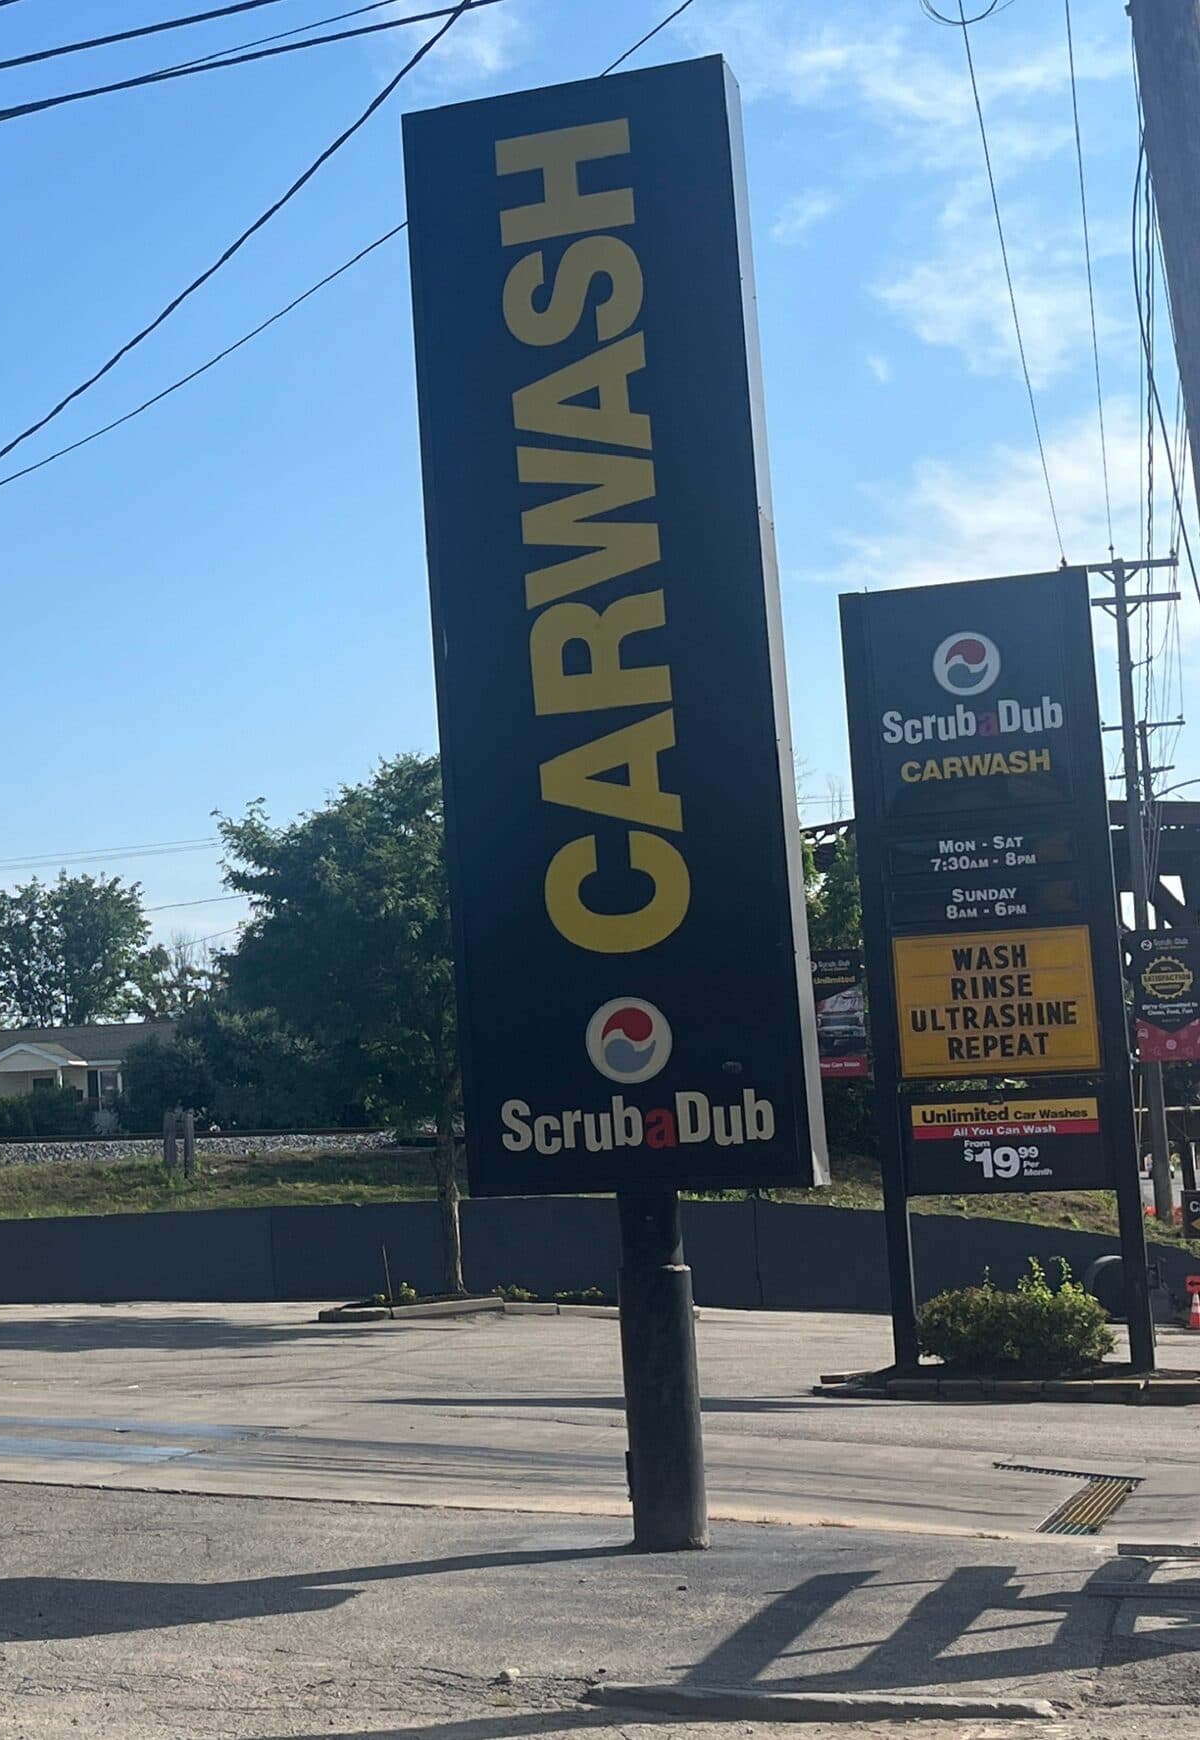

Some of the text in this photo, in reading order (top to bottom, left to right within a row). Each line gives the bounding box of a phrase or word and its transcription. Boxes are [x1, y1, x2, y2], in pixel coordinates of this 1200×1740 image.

[494, 116, 692, 954] CARWASH
[900, 748, 1051, 783] CARWASH
[952, 943, 1028, 973] WASH
[951, 973, 1033, 1001] RINSE
[911, 1001, 1077, 1033] ULTRASHINE
[948, 1031, 1049, 1061] REPEAT
[921, 1106, 1088, 1124] Unlimited Car Washes
[953, 1124, 1056, 1137] All You Can Wash
[963, 1139, 991, 1148] From
[1023, 1160, 1040, 1168] Per
[1023, 1167, 1053, 1177] Month
